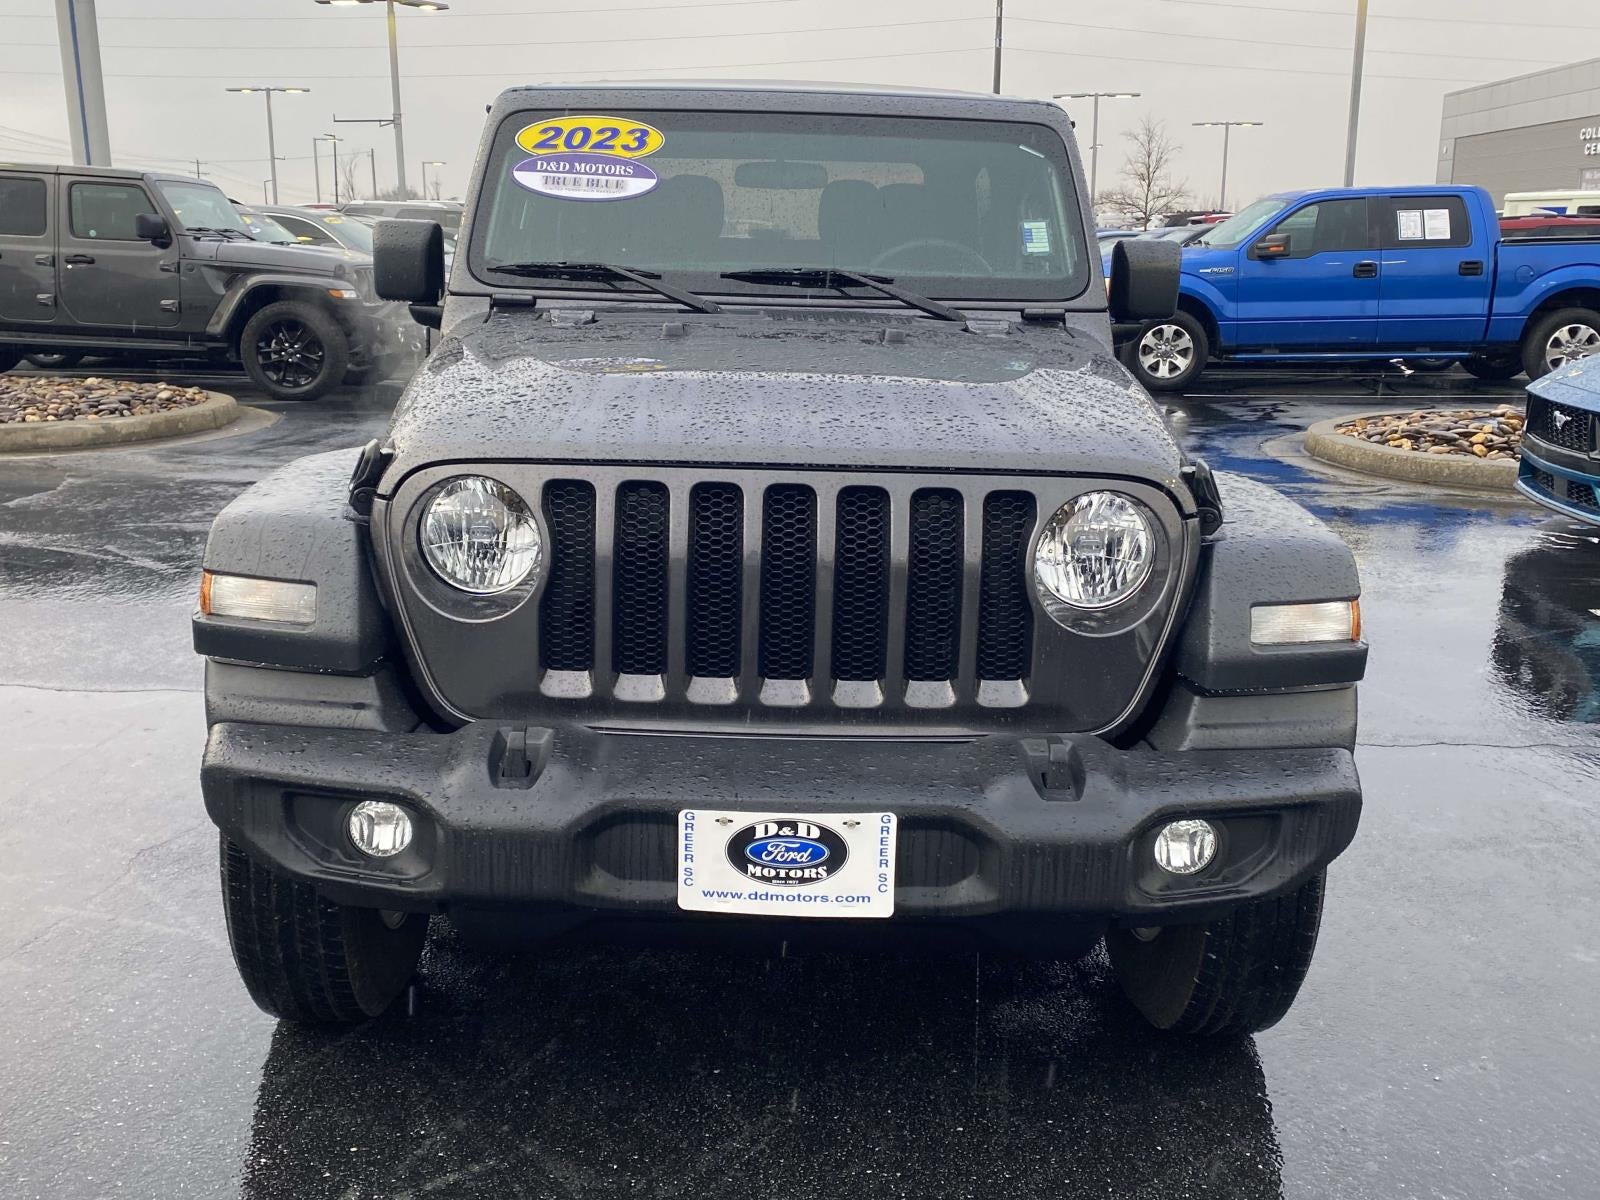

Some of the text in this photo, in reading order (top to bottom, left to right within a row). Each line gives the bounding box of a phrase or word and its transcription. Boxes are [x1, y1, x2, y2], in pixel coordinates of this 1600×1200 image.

[532, 126, 651, 151] 2023
[536, 160, 634, 176] D&D MOTORS
[542, 175, 582, 188] TRUE
[586, 177, 625, 190] BLUE
[753, 822, 821, 840] D&D
[683, 811, 696, 887] GREER SC
[761, 841, 812, 863] Ford
[877, 814, 892, 893] GREER SC
[746, 863, 828, 879] MOTORS
[702, 889, 872, 903] www.ddmotors.com
